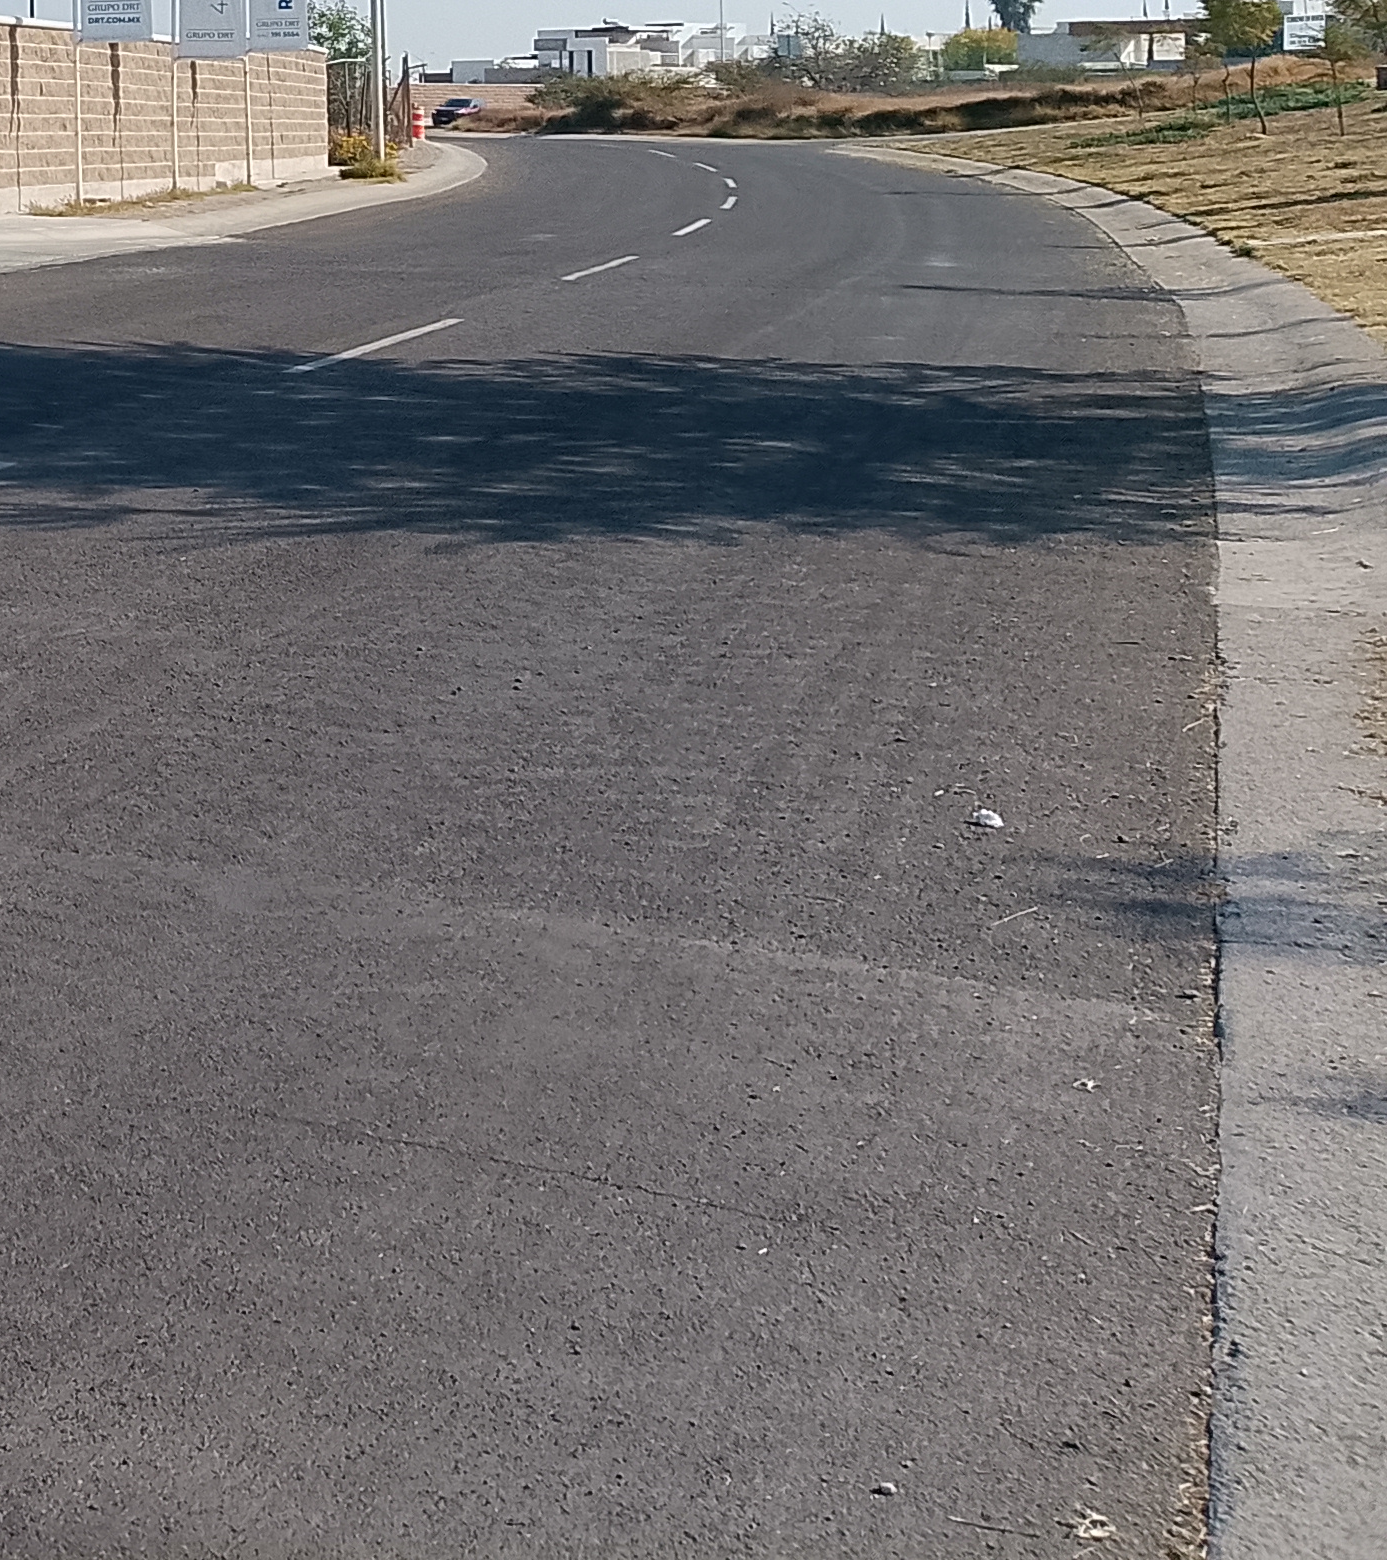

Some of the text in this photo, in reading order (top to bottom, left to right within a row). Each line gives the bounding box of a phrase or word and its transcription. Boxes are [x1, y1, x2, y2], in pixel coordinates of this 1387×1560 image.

[87, 2, 141, 13] GRUPO DRT
[186, 31, 216, 39] GRUPO
